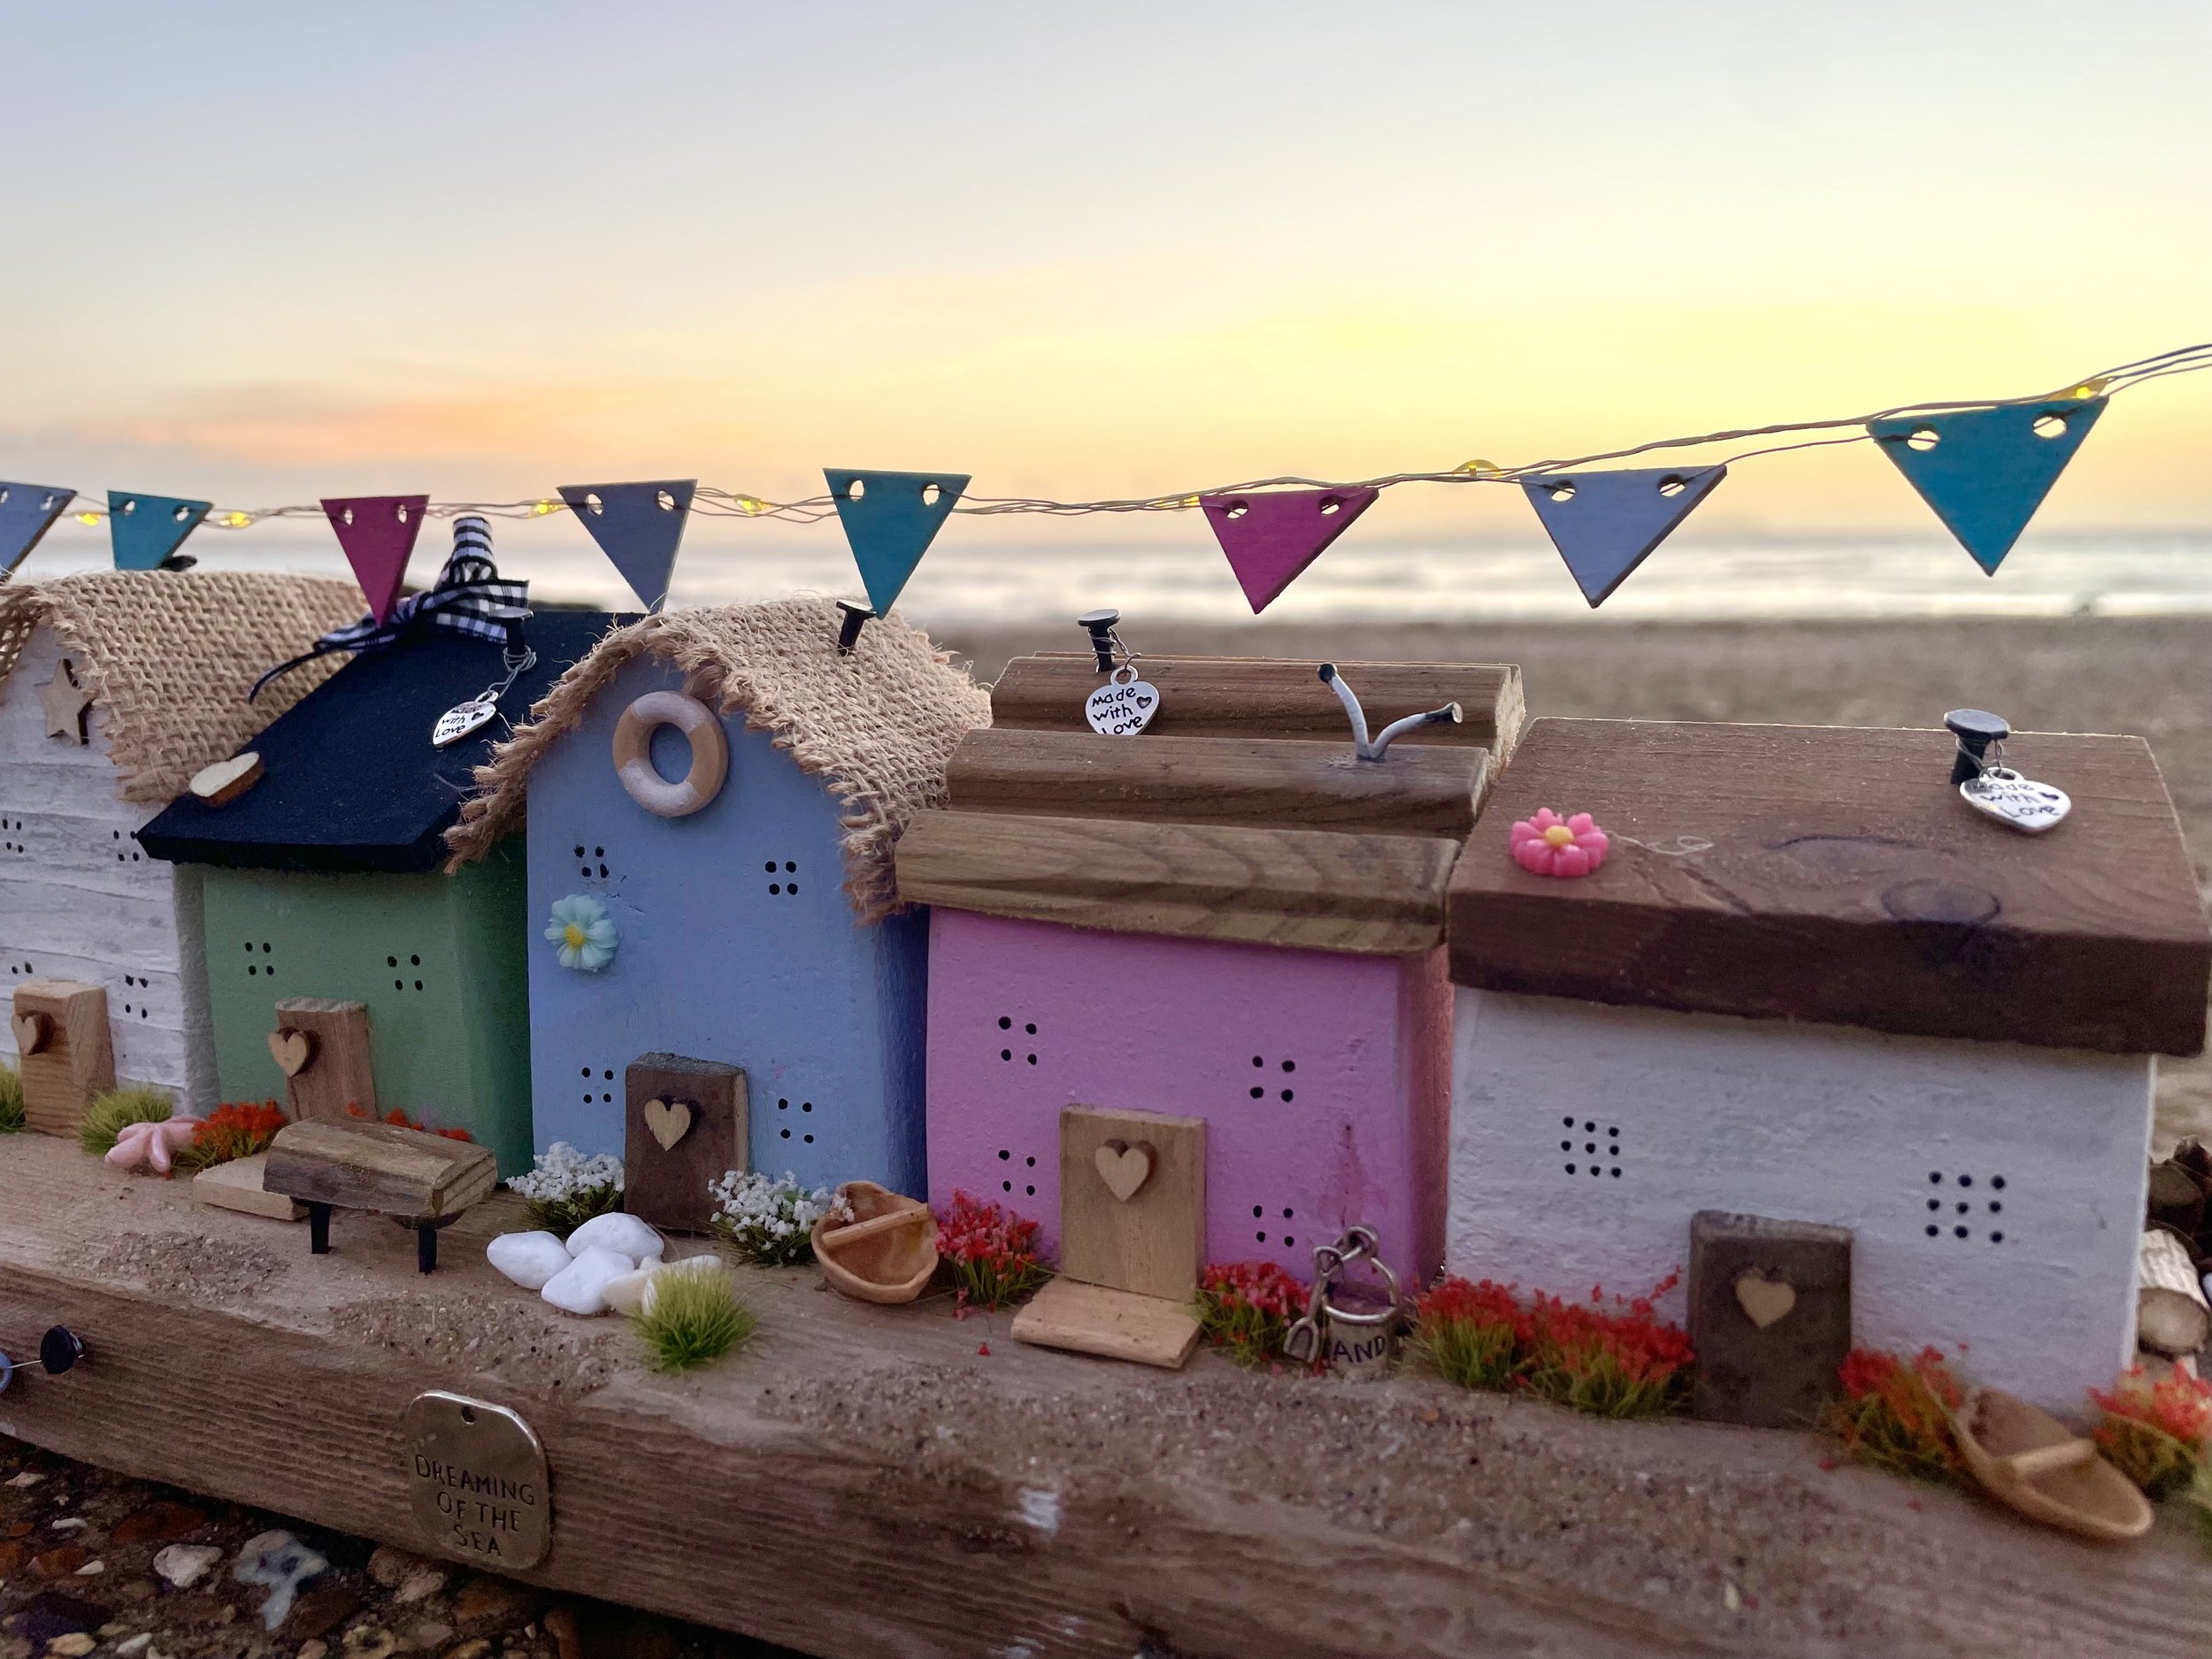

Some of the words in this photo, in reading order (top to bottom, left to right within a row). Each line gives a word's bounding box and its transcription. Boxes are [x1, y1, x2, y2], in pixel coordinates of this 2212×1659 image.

[1092, 687, 1136, 707] Made
[1093, 703, 1133, 721] with
[415, 1454, 534, 1506] DREAMING
[437, 1491, 466, 1520] OF
[474, 1502, 521, 1532] THE
[452, 1523, 503, 1557] SEA
